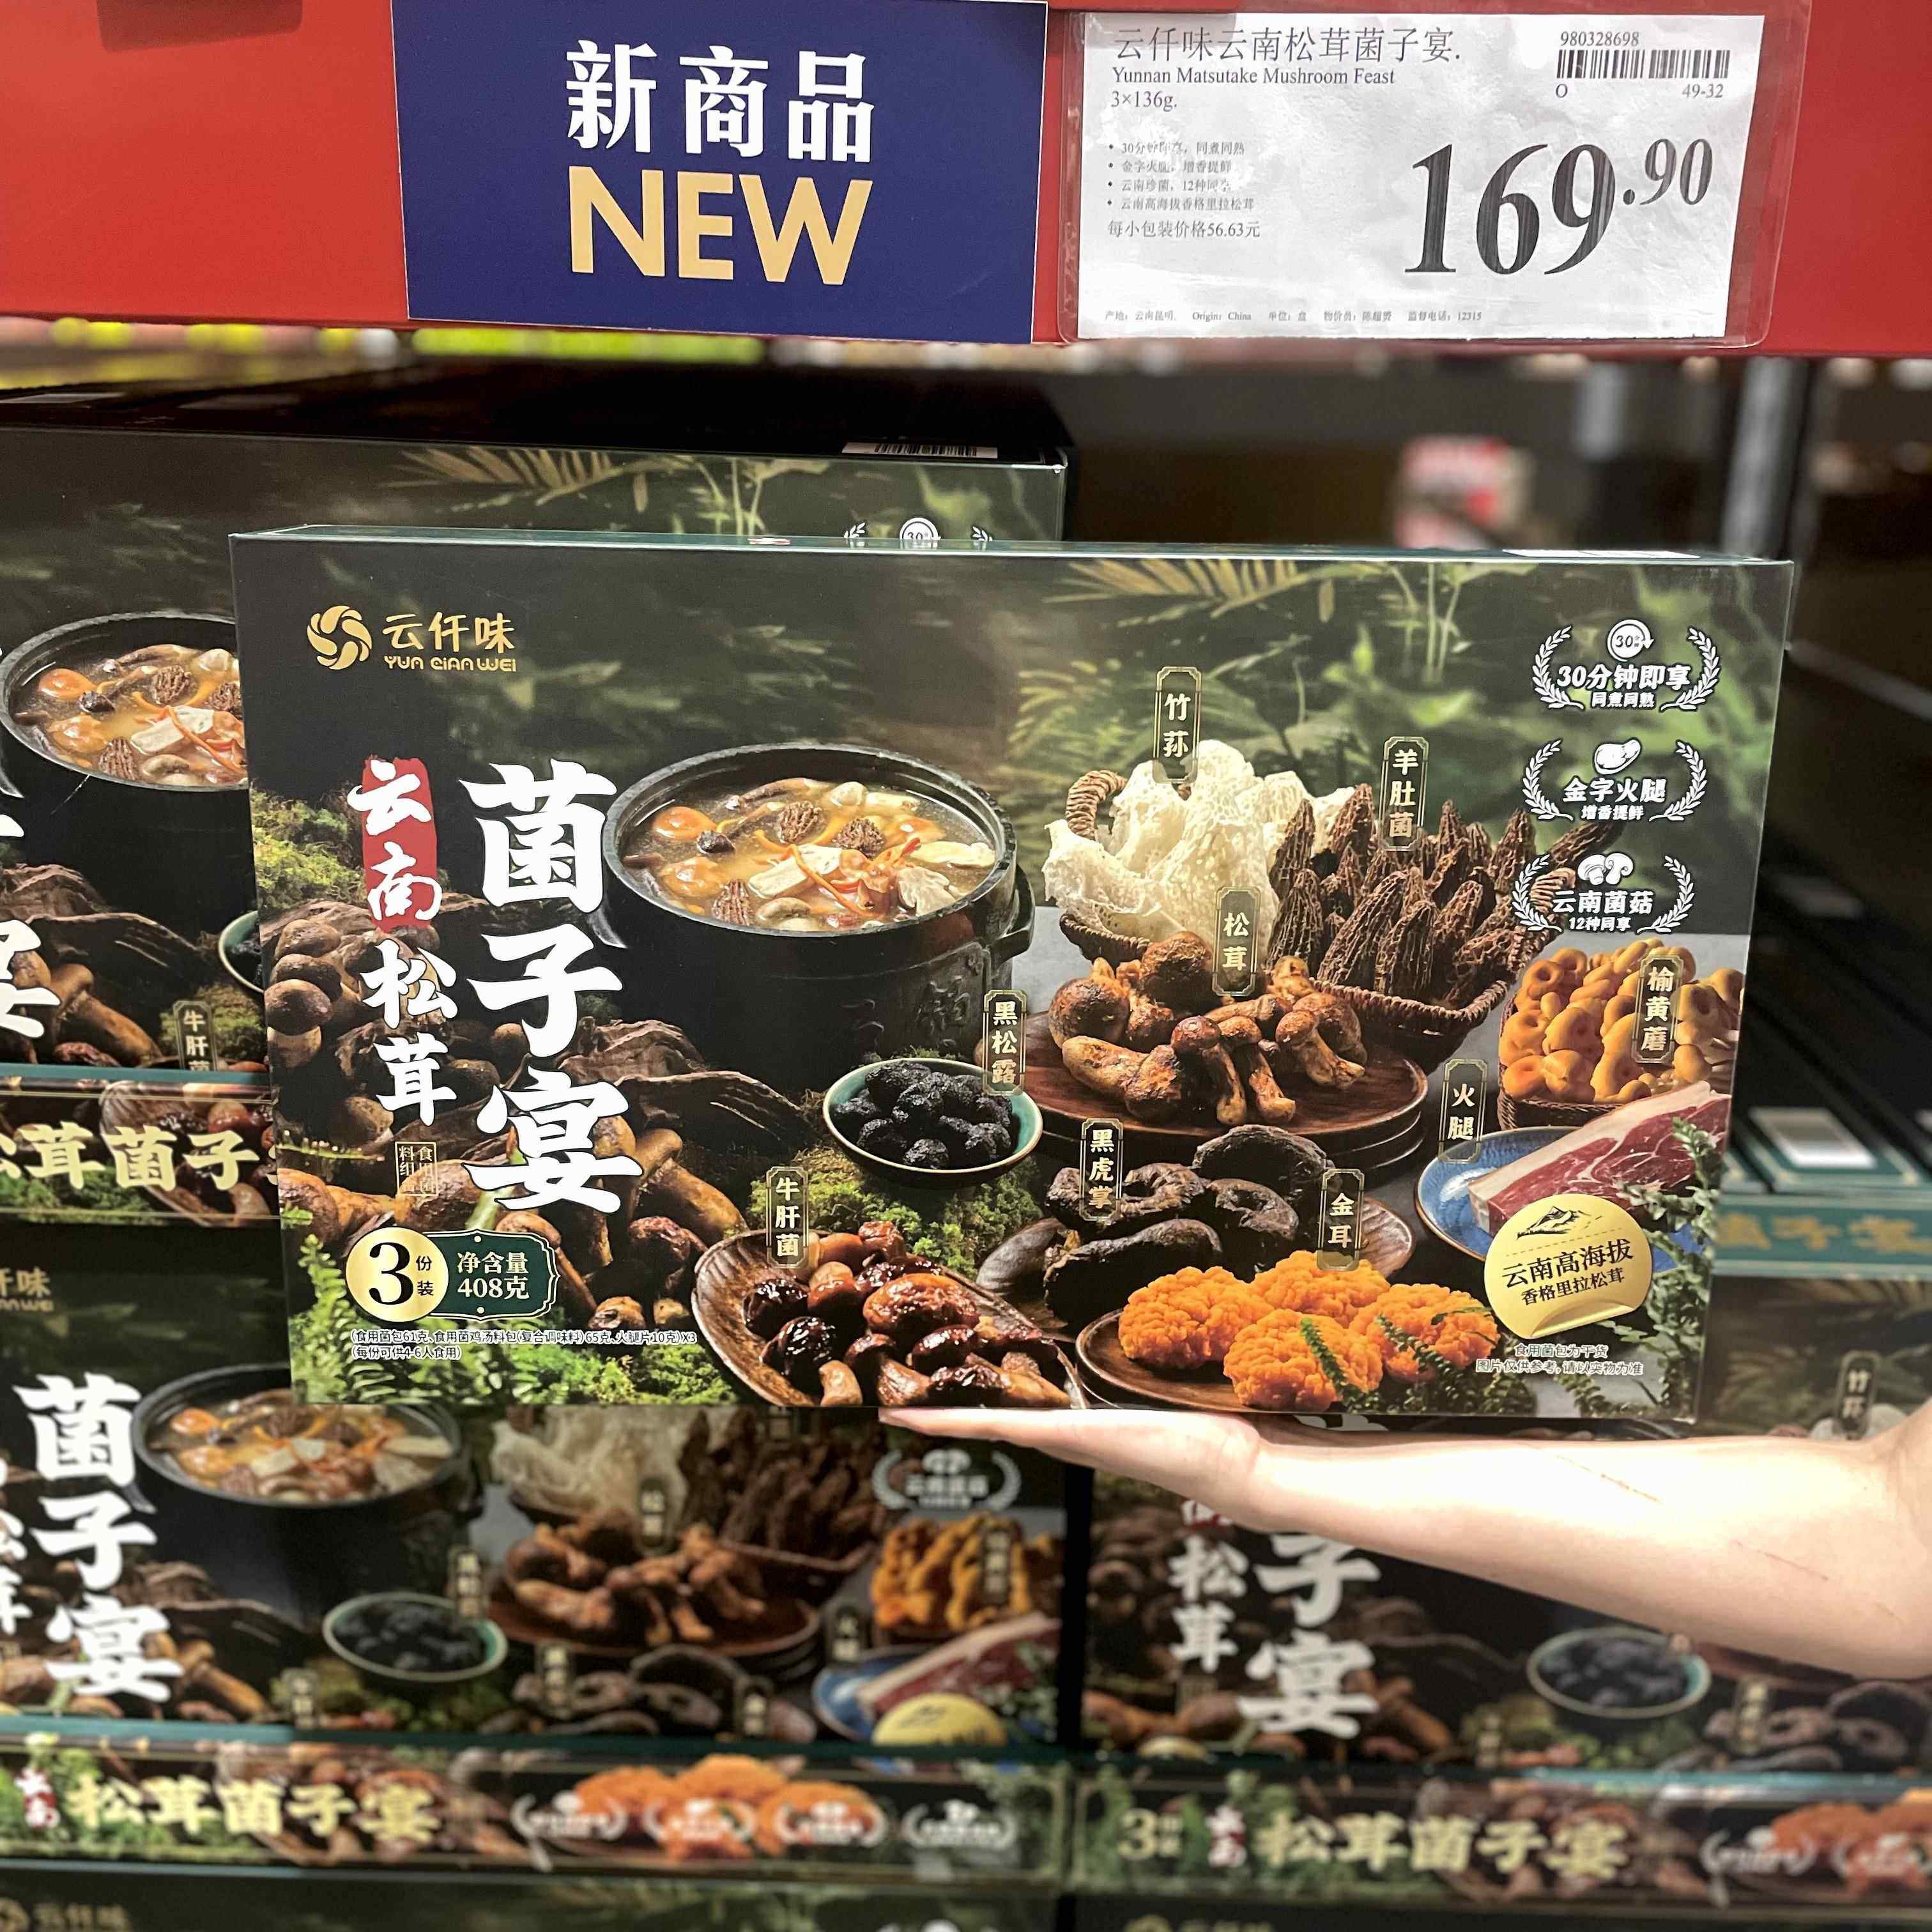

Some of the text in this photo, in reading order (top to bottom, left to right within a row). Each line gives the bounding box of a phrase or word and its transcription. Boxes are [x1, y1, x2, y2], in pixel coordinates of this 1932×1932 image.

[1114, 26, 1461, 63] 云仟味云南松茸菌子宴.
[1560, 31, 1639, 47] 980328698
[1112, 66, 1395, 85] Yunnan Matsutake Mushroom Feast
[1681, 83, 1724, 99] 49-32
[566, 39, 875, 163] 新商品
[569, 165, 873, 286] NEW
[1404, 137, 1713, 275] 169.90
[1107, 219, 1261, 238] 每小包装价格56.63元
[1227, 310, 1252, 321] China
[382, 611, 515, 654] 云仟味
[383, 655, 424, 670] YUN
[1556, 664, 1692, 691] 30分钟即享
[1591, 692, 1655, 709] 同煮同熟
[1163, 693, 1192, 758] 竹荪
[1389, 748, 1419, 838] 羊肚菌
[1561, 777, 1667, 804] 金字火腿
[1580, 804, 1644, 822] 增香提鲜
[1552, 890, 1654, 915] 云南菌菇
[1222, 911, 1250, 971] 松茸
[1568, 916, 1631, 932] 12种同享
[458, 758, 644, 1214] 菌子宴
[1640, 966, 1676, 1052] 榆黄蘑
[991, 1000, 1018, 1084] 黑松露
[1446, 1082, 1476, 1141] 火腿
[1088, 1128, 1115, 1209] 黑虎掌
[774, 1176, 801, 1257] 牛肝菌
[1327, 1192, 1355, 1248] 金耳
[456, 1251, 529, 1275] 净含量
[1502, 1238, 1635, 1288] 云南高海拔
[456, 1275, 530, 1300] 408克
[1521, 1267, 1625, 1306] 香格里拉松茸
[1514, 1343, 1609, 1359] 食用菌包为干货
[12, 1371, 184, 1703] 菌子宴
[1167, 1535, 1250, 1673] 松茸
